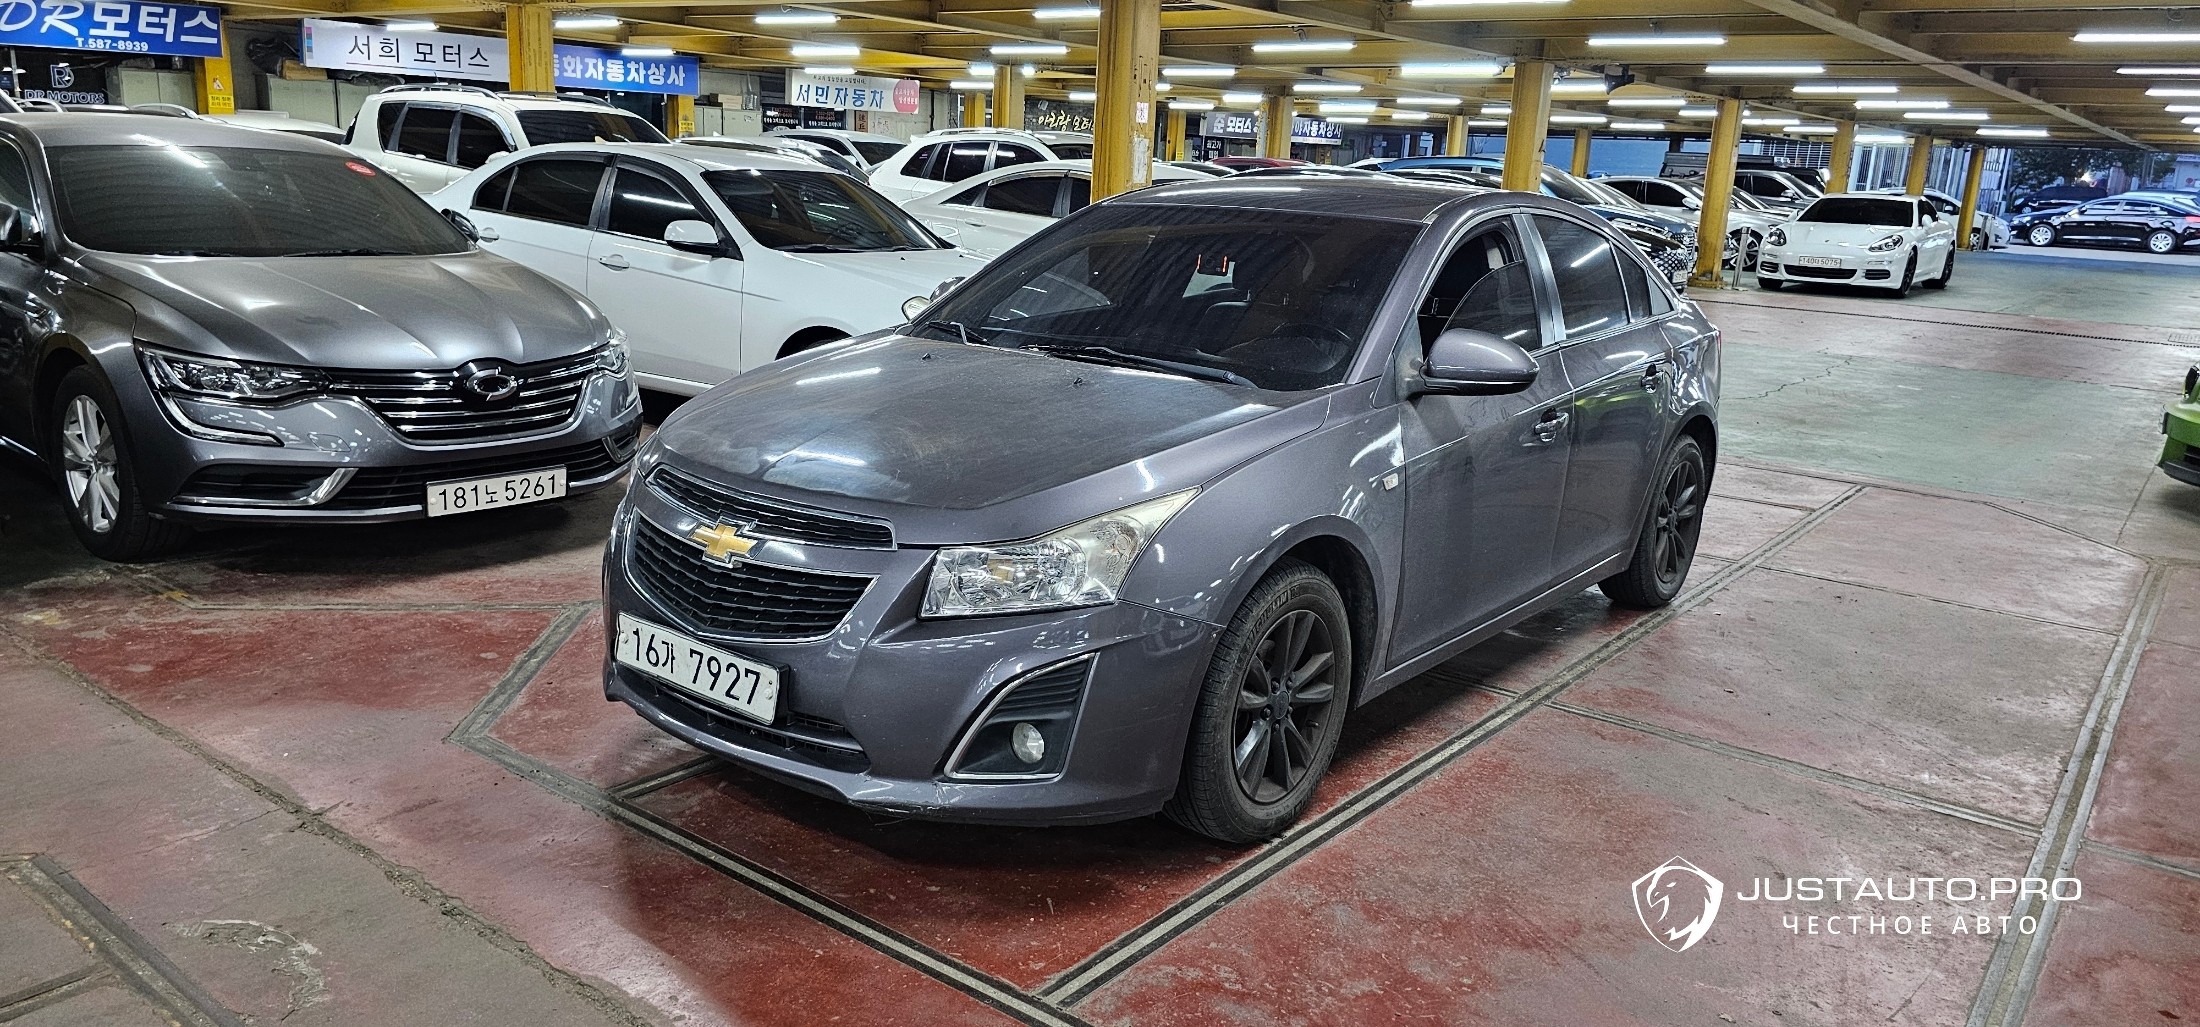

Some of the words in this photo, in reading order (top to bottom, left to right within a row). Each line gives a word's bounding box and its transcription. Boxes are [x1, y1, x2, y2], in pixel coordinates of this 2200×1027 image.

[75, 37, 149, 51] T.587-8939
[348, 35, 400, 63] 서희
[413, 42, 490, 68] 모터스
[47, 90, 105, 104] MOTORS
[796, 84, 885, 109] 서민자동차
[1072, 115, 1095, 131] 모터
[1226, 116, 1252, 134] 모터스
[438, 484, 499, 511] 181노
[504, 474, 556, 502] 5261
[632, 627, 676, 674] 16가
[689, 647, 761, 705] 7927
